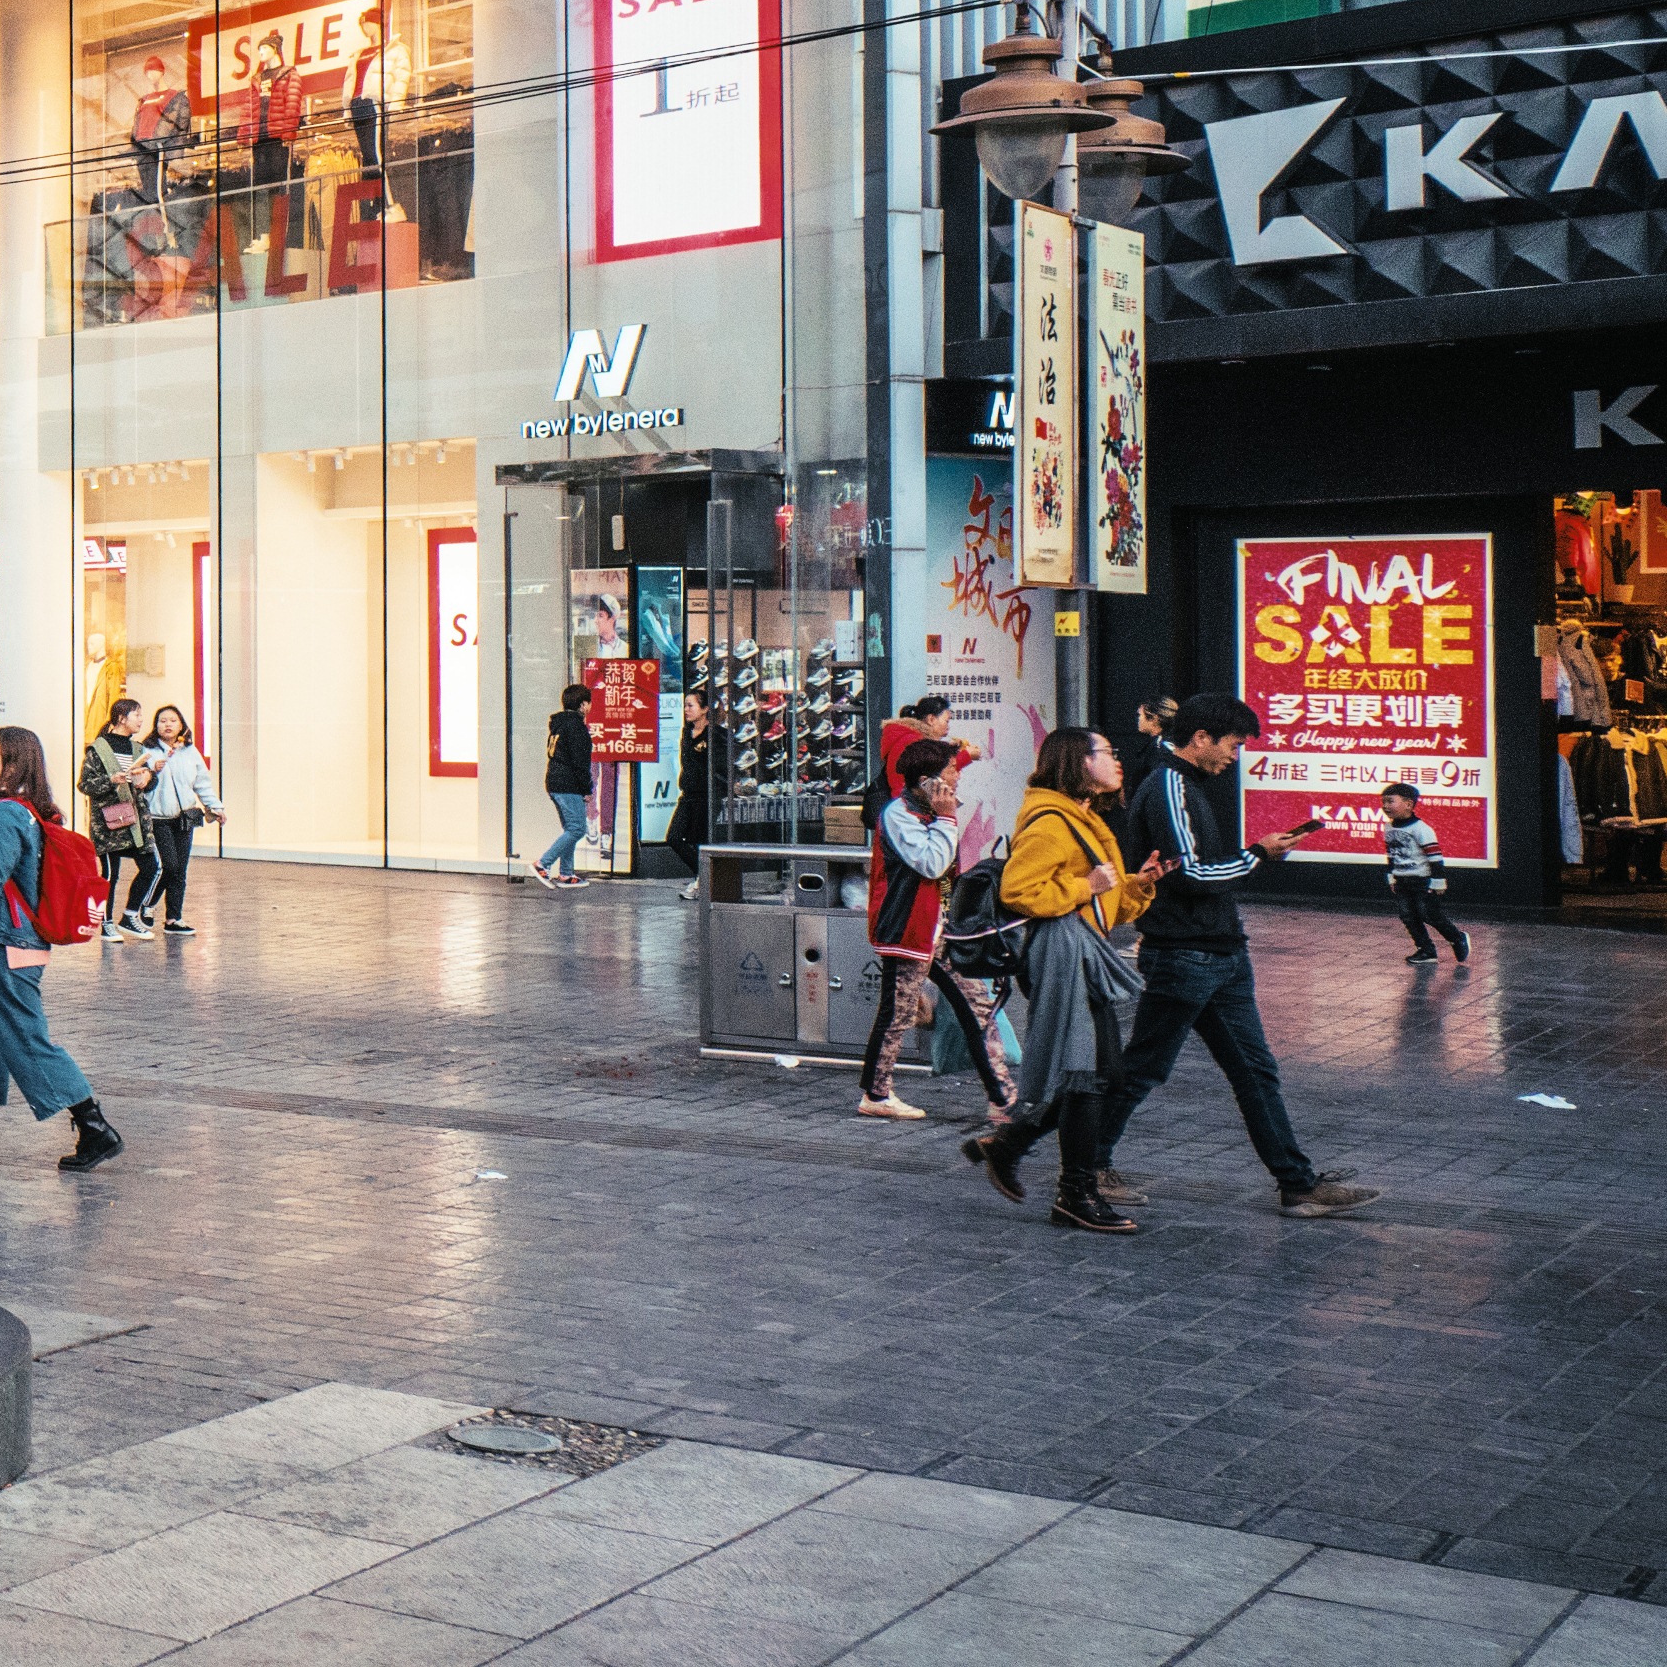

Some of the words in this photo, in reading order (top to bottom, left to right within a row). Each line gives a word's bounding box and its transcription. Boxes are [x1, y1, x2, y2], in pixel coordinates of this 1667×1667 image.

[638, 56, 740, 121] 1折起
[1039, 293, 1057, 405] 法治
[521, 417, 570, 440] new
[572, 406, 681, 439] bylenera
[1277, 549, 1456, 605] FINAL
[1253, 604, 1473, 664] SALE
[605, 663, 635, 684] 恭贺
[1304, 668, 1428, 690] 年终大放价
[605, 685, 635, 707] 新年
[1268, 693, 1463, 728] 多买更划算
[1293, 730, 1357, 753] Happy
[1359, 738, 1392, 748] new
[1395, 733, 1440, 754] year!
[1249, 756, 1308, 781] 4折起
[1320, 760, 1481, 787] 三件以上再享9折
[1325, 821, 1349, 832] OWN
